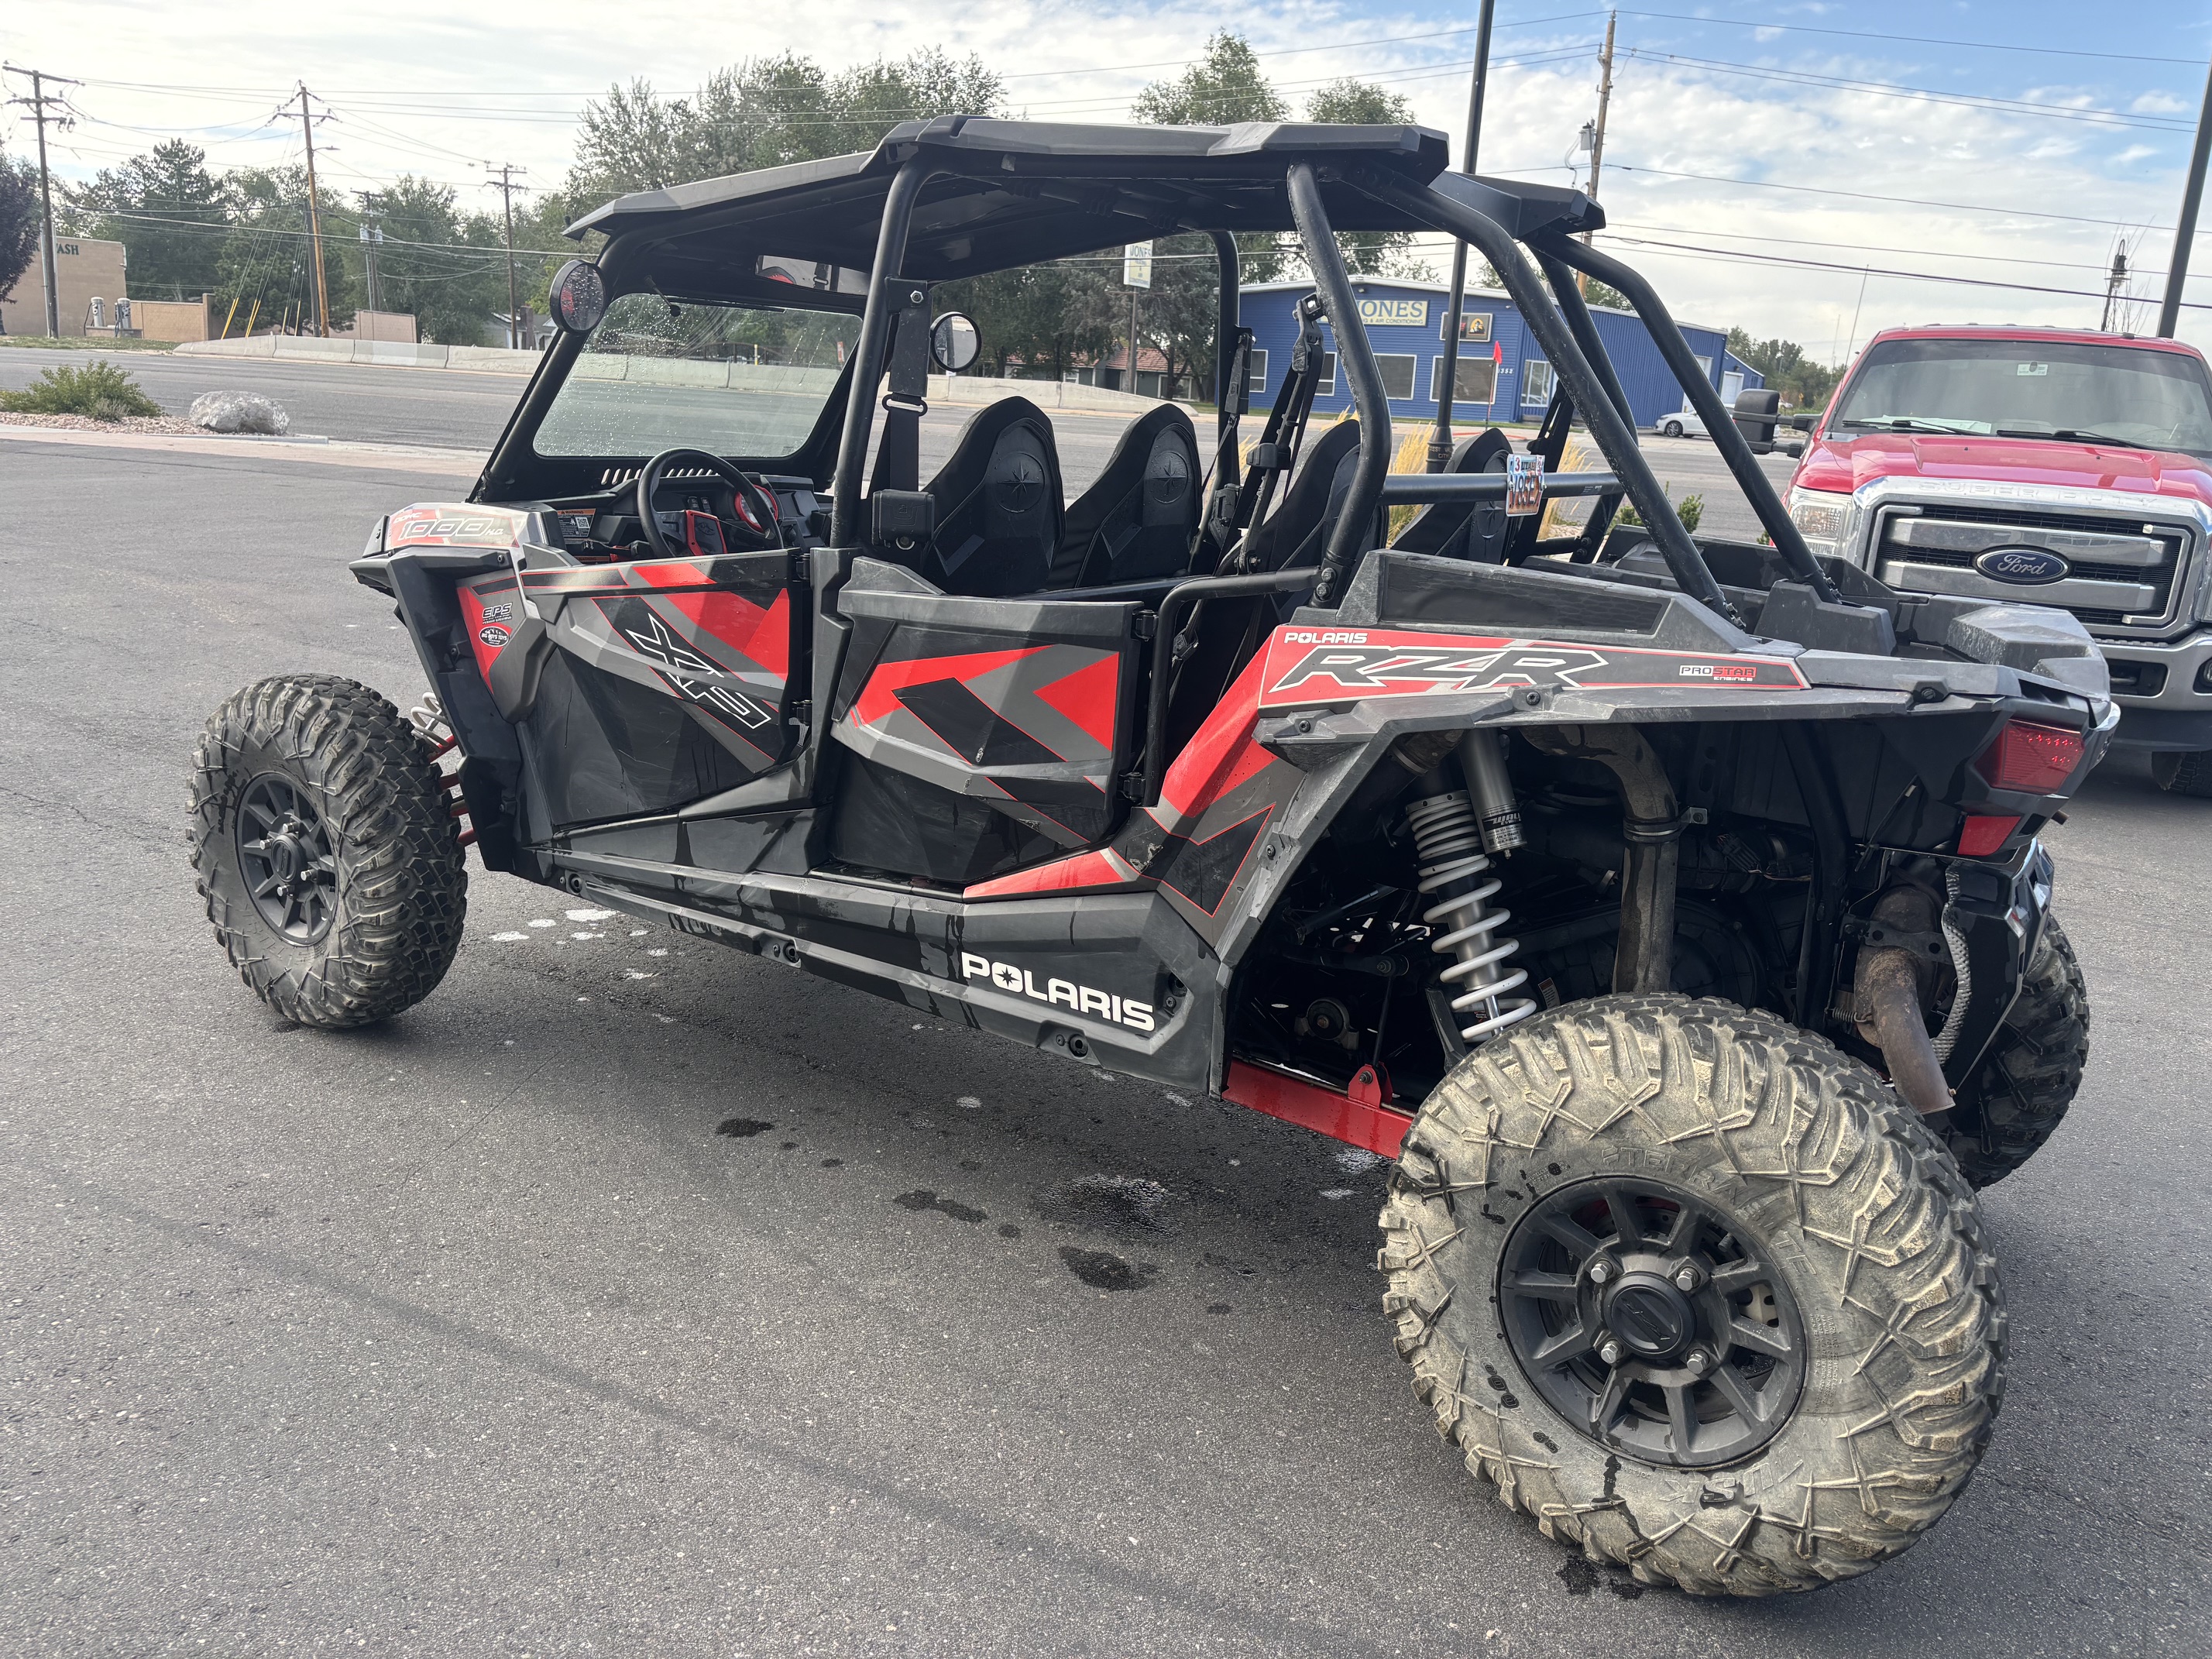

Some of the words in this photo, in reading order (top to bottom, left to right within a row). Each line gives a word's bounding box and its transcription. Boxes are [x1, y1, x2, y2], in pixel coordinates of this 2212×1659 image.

[57, 242, 80, 256] ASH
[393, 511, 423, 524] DOHC
[397, 517, 495, 541] 1000
[1997, 554, 2048, 576] Ford
[482, 602, 513, 619] EPS
[1283, 632, 1368, 644] POLARIS
[961, 951, 1156, 1032] POLARIS
